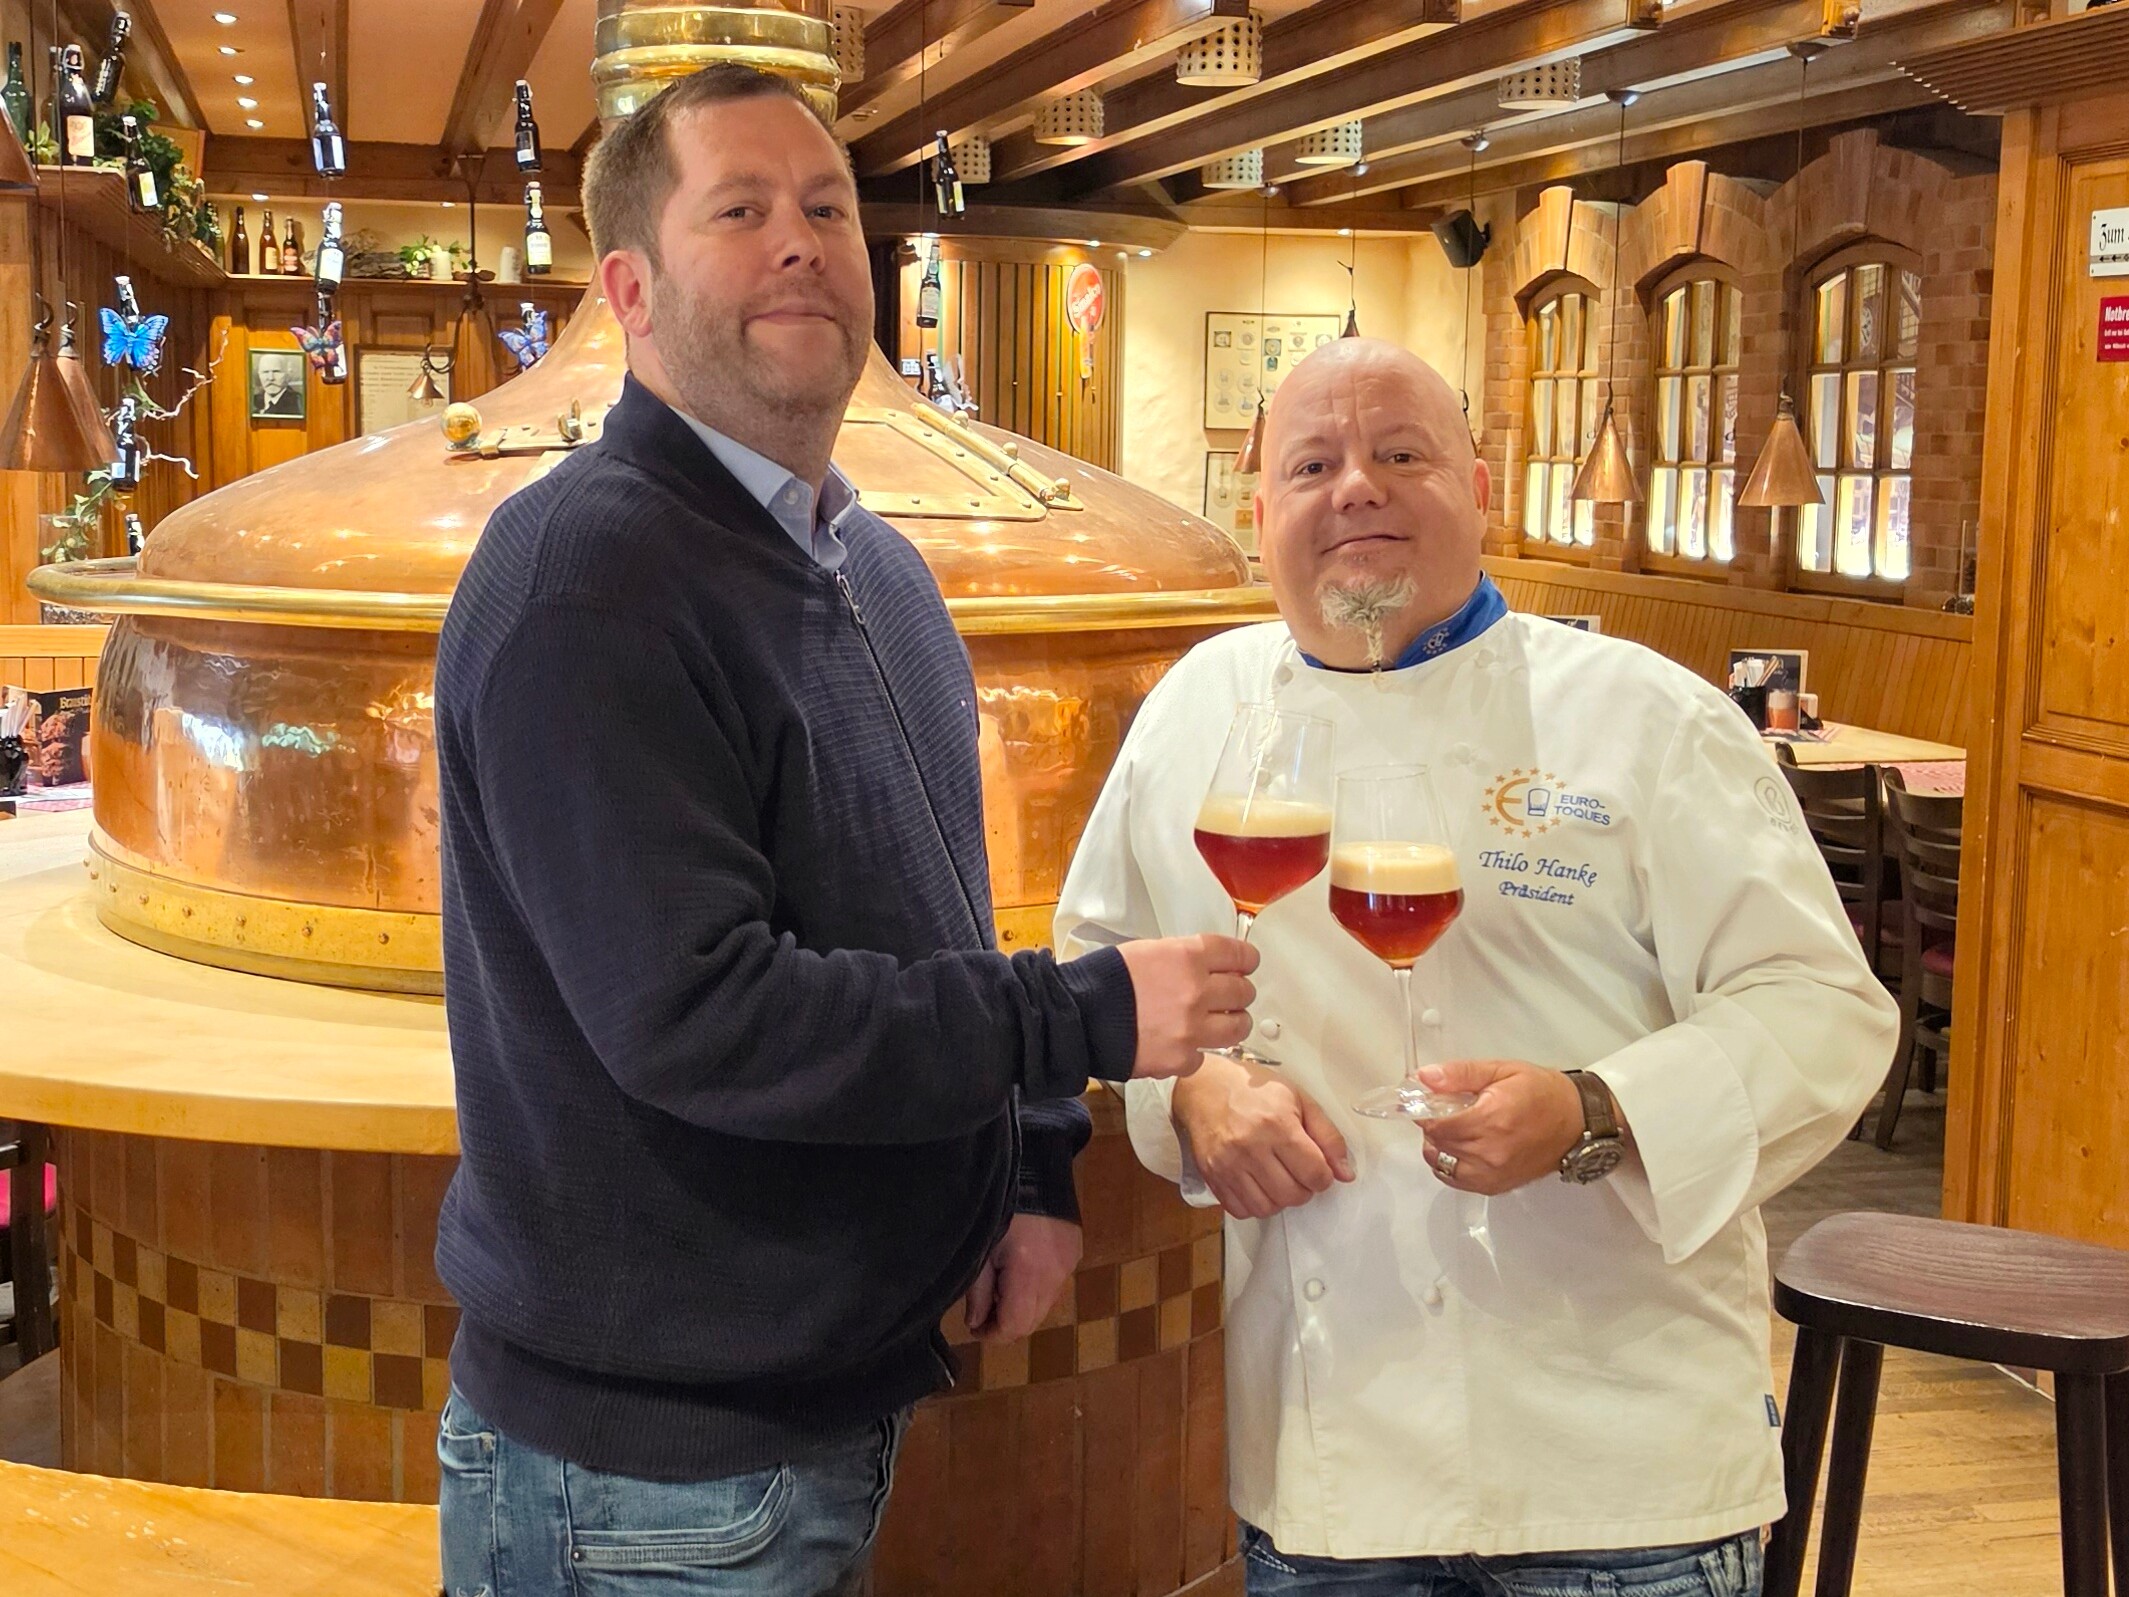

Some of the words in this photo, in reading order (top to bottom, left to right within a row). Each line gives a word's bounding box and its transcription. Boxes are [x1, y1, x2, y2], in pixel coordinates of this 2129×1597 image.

[2099, 223, 2124, 251] Zum
[1559, 794, 1606, 809] EURO-
[1554, 805, 1611, 826] TOQUES
[1479, 850, 1529, 872] Thilo
[1534, 858, 1598, 888] Hanke
[1499, 881, 1575, 906] Präsident
